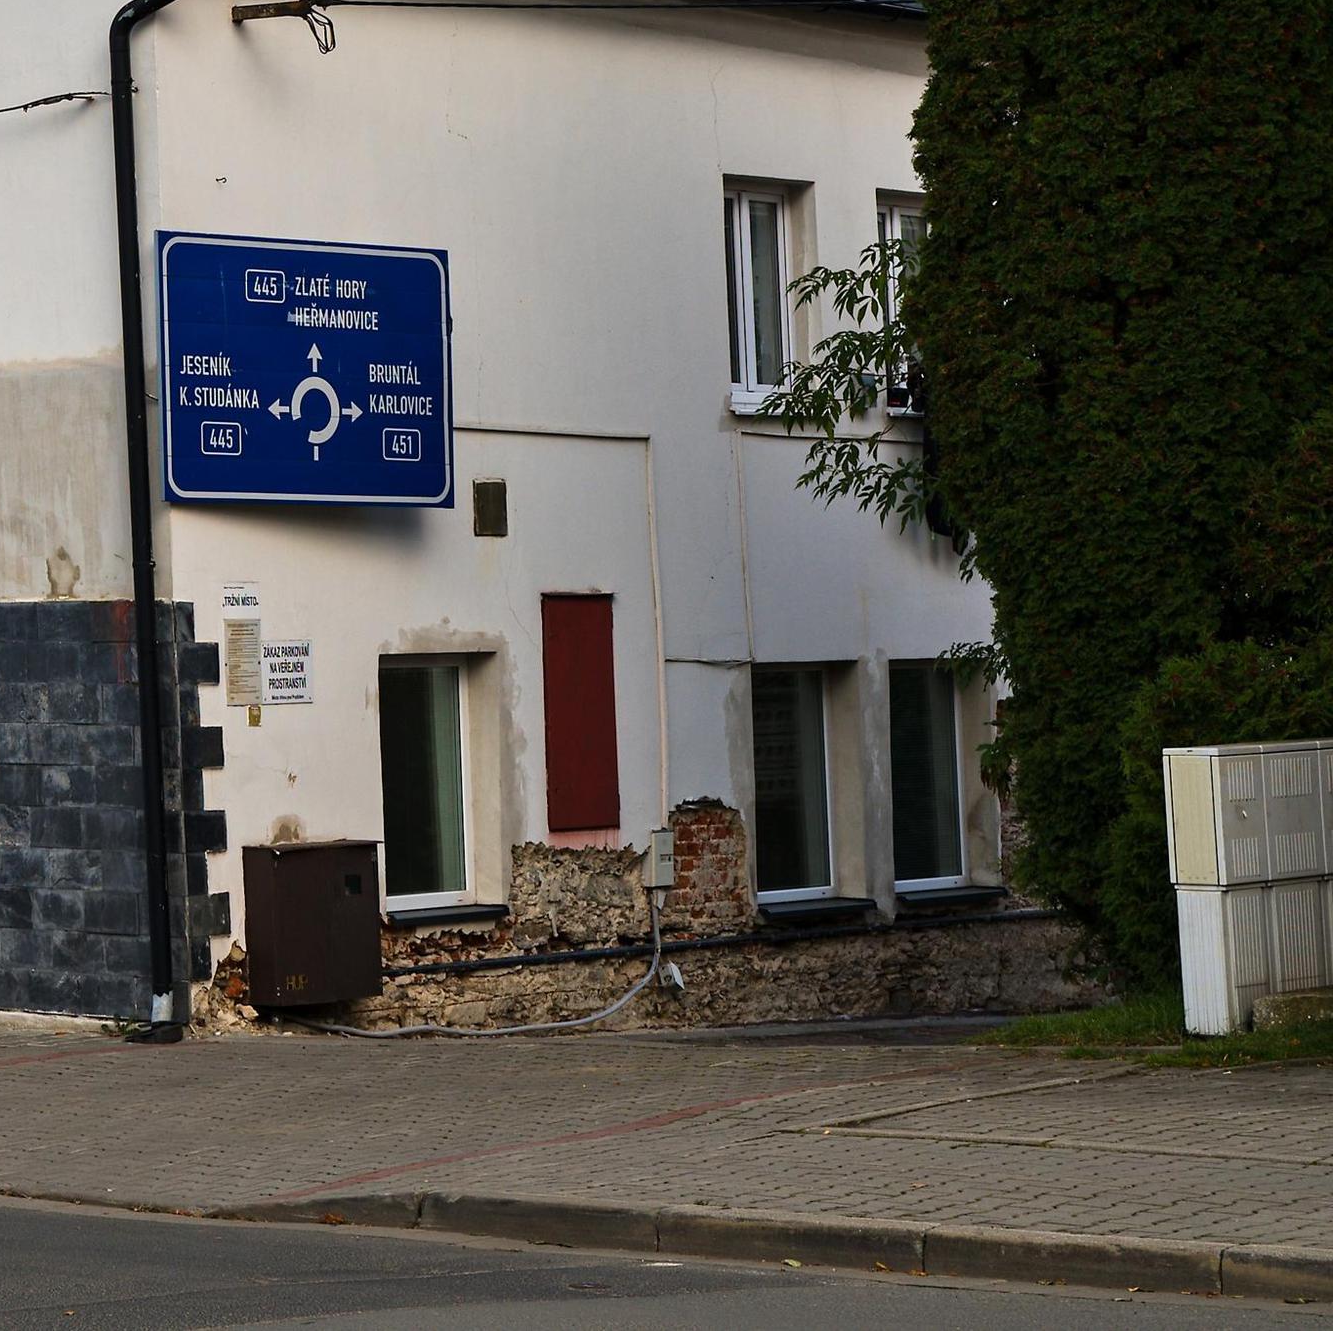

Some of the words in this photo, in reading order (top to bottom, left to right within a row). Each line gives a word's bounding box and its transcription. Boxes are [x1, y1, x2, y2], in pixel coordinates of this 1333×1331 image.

[253, 276, 278, 296] 445
[295, 273, 330, 298] ZLATÉ
[336, 279, 367, 300] HORY
[295, 303, 379, 331] HEŘMANOVICE
[180, 352, 232, 377] JESENÍK
[369, 361, 421, 385] BRUNTÁL
[180, 386, 192, 406] K.
[194, 383, 260, 410] STUDÁNKA
[370, 393, 433, 416] KARLOVICE
[209, 428, 234, 449] 445
[391, 435, 413, 455] 451
[263, 644, 280, 658] ZÁKAZ
[281, 643, 310, 658] PARKOVÁNÍ
[269, 662, 277, 673] NA
[277, 659, 304, 673] VEŘEJNÉM
[268, 674, 307, 689] PROSTRANSTVÍ
[286, 974, 309, 990] HUP
